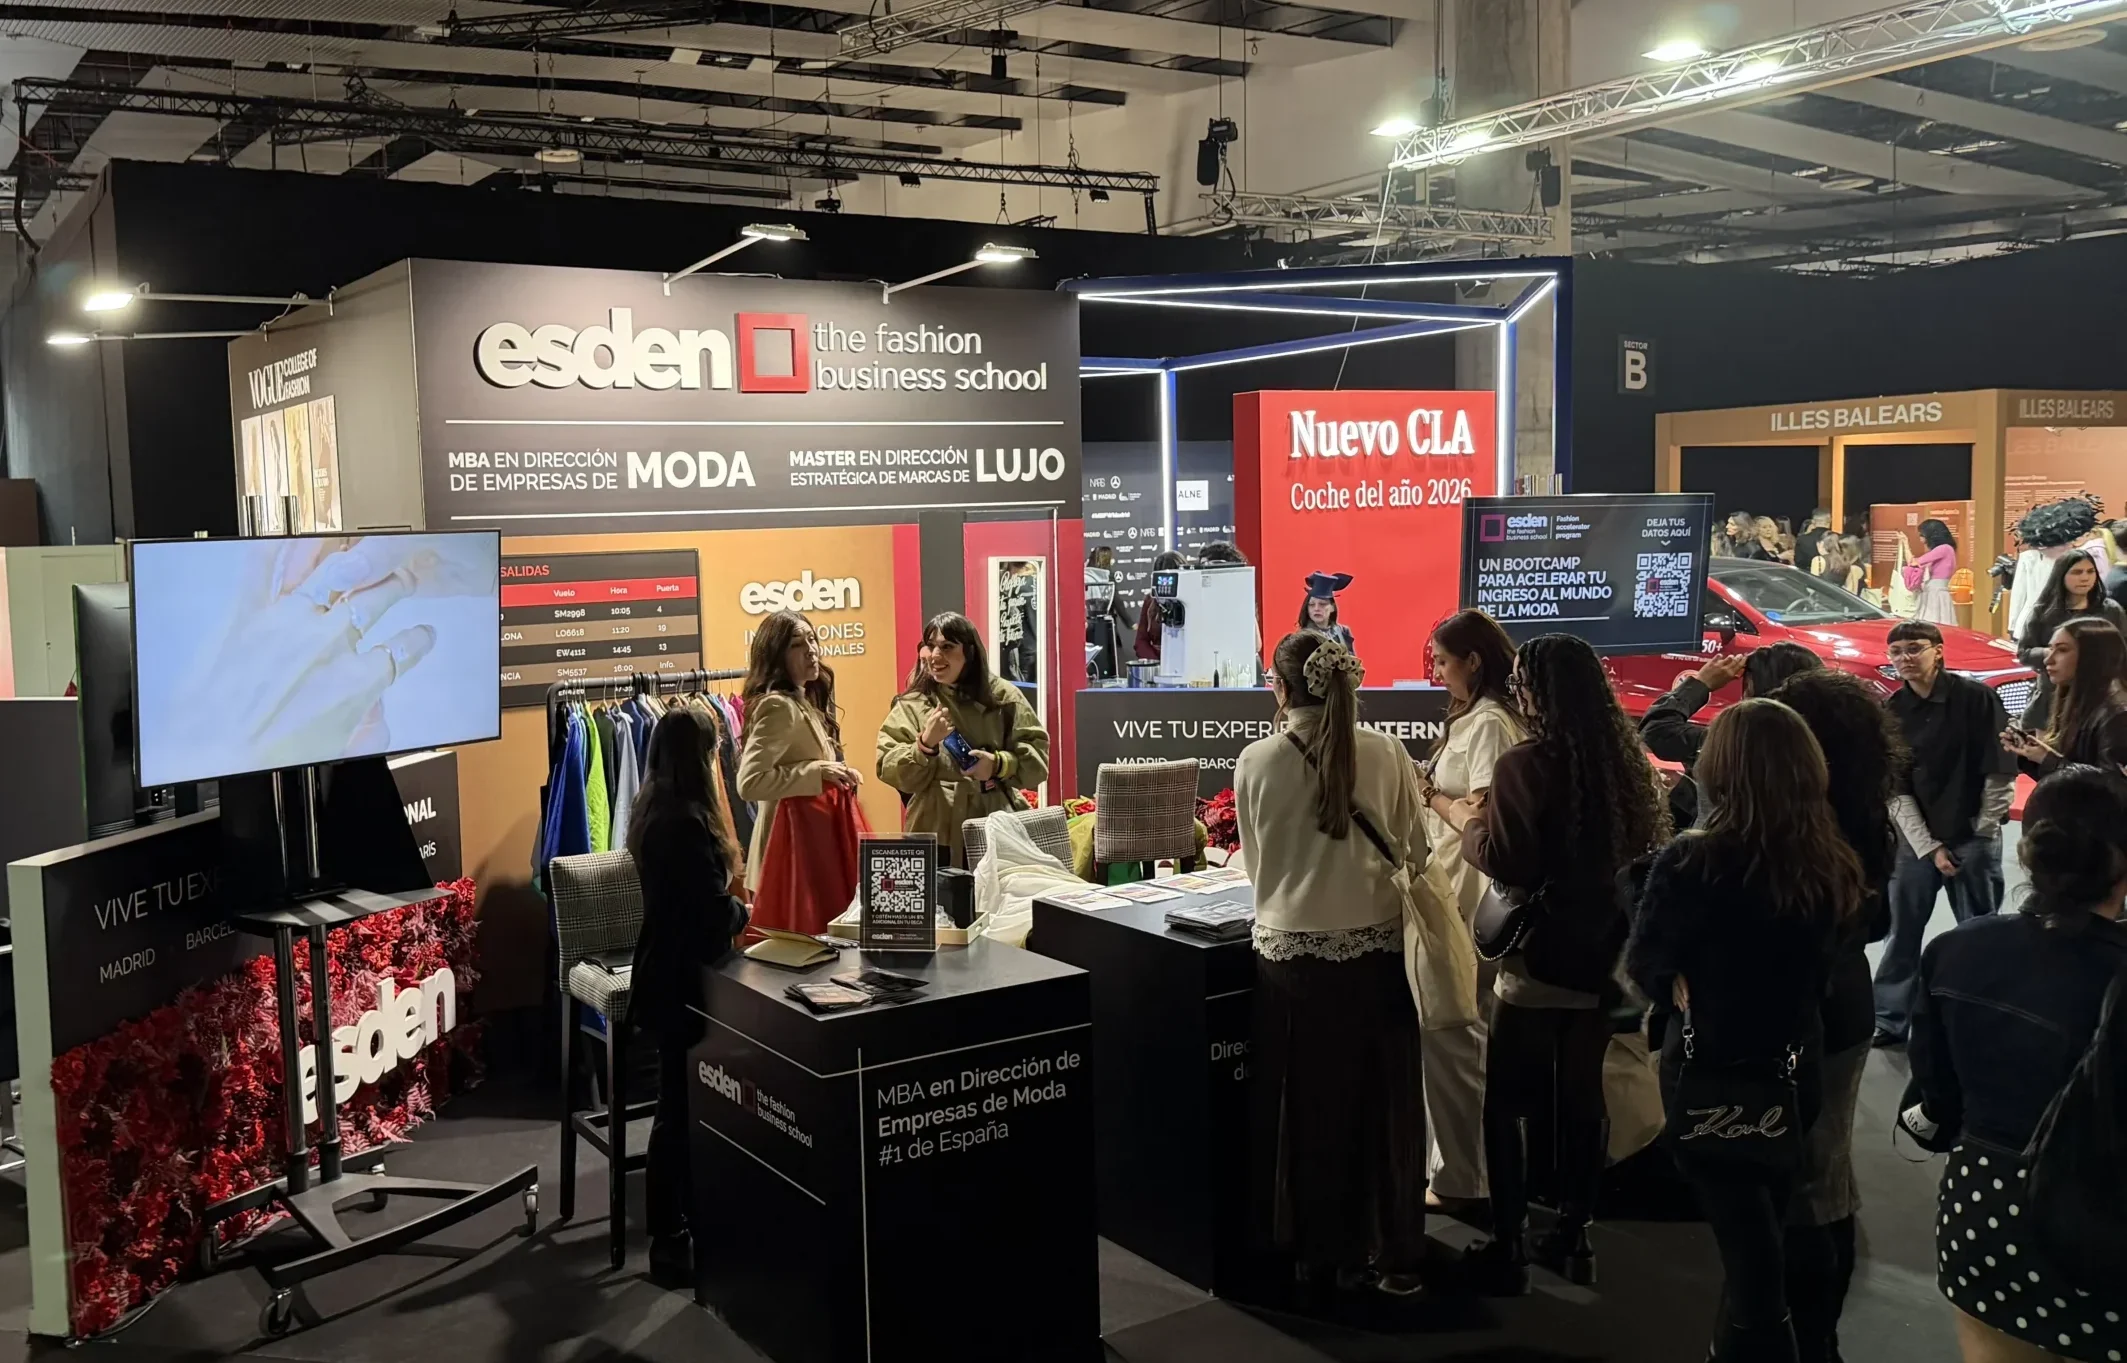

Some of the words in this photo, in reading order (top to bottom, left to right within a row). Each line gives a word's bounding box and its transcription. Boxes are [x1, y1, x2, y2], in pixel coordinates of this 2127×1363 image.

[814, 321, 866, 353] the
[875, 322, 982, 354] fashion
[1624, 340, 1648, 350] SECTOR
[473, 307, 732, 390] esden
[284, 351, 309, 377] COLLEGE
[1625, 350, 1647, 390] B
[248, 361, 285, 409] VOGUE
[816, 359, 946, 390] business
[955, 361, 1047, 391] school
[284, 375, 310, 400] FASHION
[1771, 410, 1829, 432] ILLES
[1834, 402, 1942, 428] BALEARS
[2019, 399, 2056, 418] ILLES
[2057, 399, 2115, 419] BALEARS
[1289, 410, 1400, 458] Nuevo
[1407, 408, 1476, 455] CLA
[449, 452, 490, 468] MBA
[494, 452, 519, 468] EN
[524, 448, 617, 468] DIRECCIÓN
[789, 451, 856, 467] MASTER
[860, 450, 881, 466] EN
[885, 446, 968, 466] DIRECCIÓN
[976, 447, 1066, 483] LUJO
[626, 451, 757, 489] MODA
[790, 469, 877, 486] ESTRATÉGICA
[880, 471, 896, 484] DE
[899, 470, 950, 484] MARCAS
[953, 470, 970, 483] DE
[450, 474, 478, 491] DE
[483, 473, 587, 491] EMPRESAS
[592, 473, 618, 489] DE
[1291, 481, 1350, 511] Coche
[1355, 480, 1384, 507] del
[1389, 478, 1422, 506] año
[1428, 477, 1472, 505] 2026
[1507, 513, 1548, 528] esden
[1556, 515, 1580, 523] Fashion
[1556, 523, 1590, 531] accelerator
[1646, 518, 1668, 527] DEJA
[1668, 518, 1686, 527] TUS
[1556, 532, 1582, 540] program
[1642, 529, 1669, 538] DATOS
[1670, 526, 1691, 538] AQUÍ
[501, 565, 550, 577] SALIDAS
[1479, 559, 1500, 572] UN
[1503, 556, 1580, 571] BOOTCAMP
[1478, 574, 1517, 588] PARA
[1518, 572, 1585, 586] ACELERAR
[1588, 571, 1606, 584] TU
[553, 589, 576, 598] Vuelo
[610, 587, 628, 595] Hora
[656, 584, 680, 592] Puerta
[740, 570, 860, 615] esden
[1478, 588, 1539, 603] INGRESO
[1541, 588, 1559, 601] AL
[1561, 586, 1612, 600] MUNDO
[554, 609, 586, 619] SM2998
[611, 607, 631, 616] 10:05
[657, 605, 662, 613] 4
[1477, 604, 1496, 617] DE
[1499, 604, 1516, 617] LA
[1518, 603, 1560, 617] MODA
[612, 626, 630, 634] 11:20
[658, 624, 667, 632] 19
[556, 648, 586, 657] EW4112
[613, 646, 632, 654] 14:45
[658, 643, 667, 651] 13
[557, 668, 588, 678] SM5537
[613, 664, 633, 673] 16:00
[659, 661, 675, 669] Info.
[1113, 720, 1162, 739] VIVE
[1167, 720, 1198, 739] TU
[94, 889, 148, 930] VIVE
[152, 877, 183, 911] TU
[100, 948, 156, 984] MADRID
[299, 967, 457, 1125] esden
[698, 1060, 742, 1105] esden
[877, 1081, 925, 1109] MBA
[929, 1078, 954, 1097] en
[960, 1056, 1051, 1091] Dirección
[1056, 1050, 1081, 1071] de
[756, 1088, 769, 1106] the
[769, 1096, 796, 1122] fashion
[878, 1101, 978, 1138] Empresas
[982, 1093, 1008, 1114] de
[1013, 1080, 1067, 1107] Moda
[757, 1102, 787, 1133] business
[788, 1124, 813, 1148] school
[878, 1144, 903, 1167] #1
[908, 1137, 934, 1159] de
[940, 1120, 1009, 1152] España
